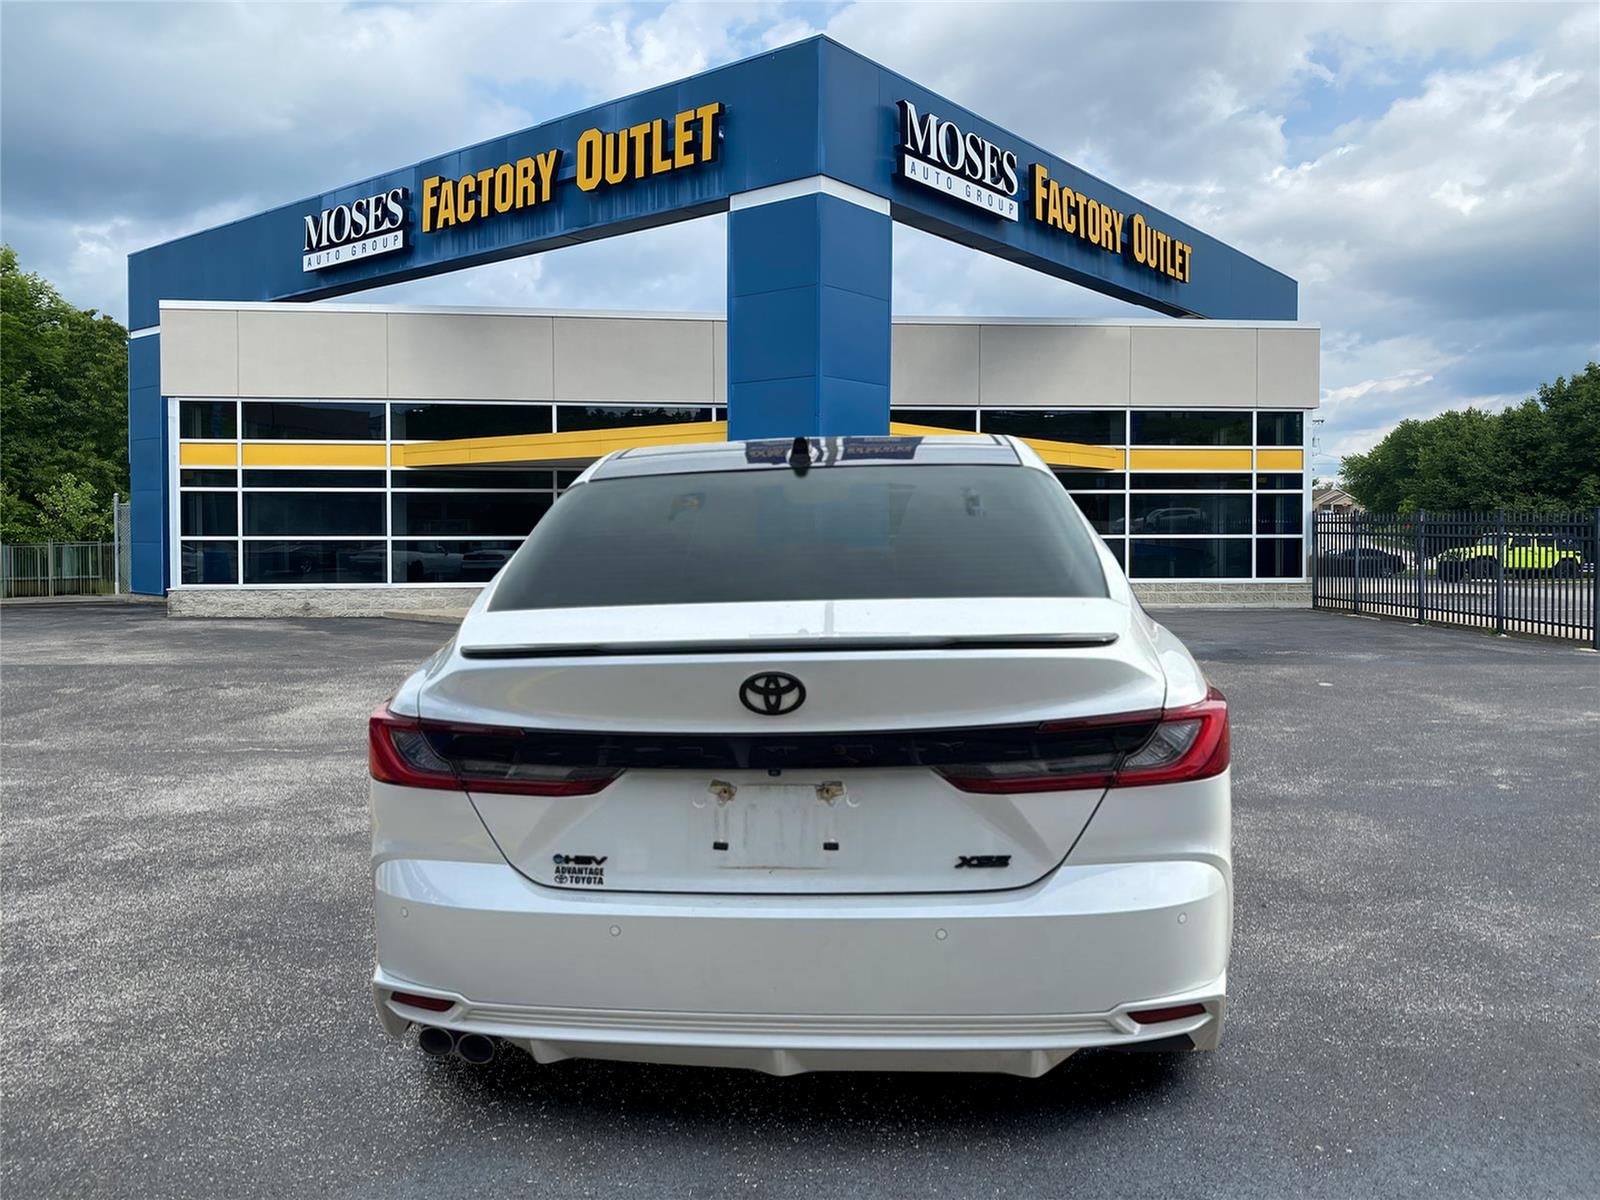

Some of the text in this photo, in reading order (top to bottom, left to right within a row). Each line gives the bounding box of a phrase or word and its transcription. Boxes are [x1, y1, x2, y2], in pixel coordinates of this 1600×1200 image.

[422, 102, 721, 233] FACTORY OUTLET
[904, 100, 1019, 196] MOSES
[909, 161, 1016, 215] AUTO GROUP
[303, 187, 404, 251] MOSES
[1034, 164, 1192, 283] FACTORY OUTLET
[306, 234, 399, 268] AUTO GROUP
[554, 865, 605, 877] ADVANTAGE
[569, 875, 604, 886] TOYOTA
